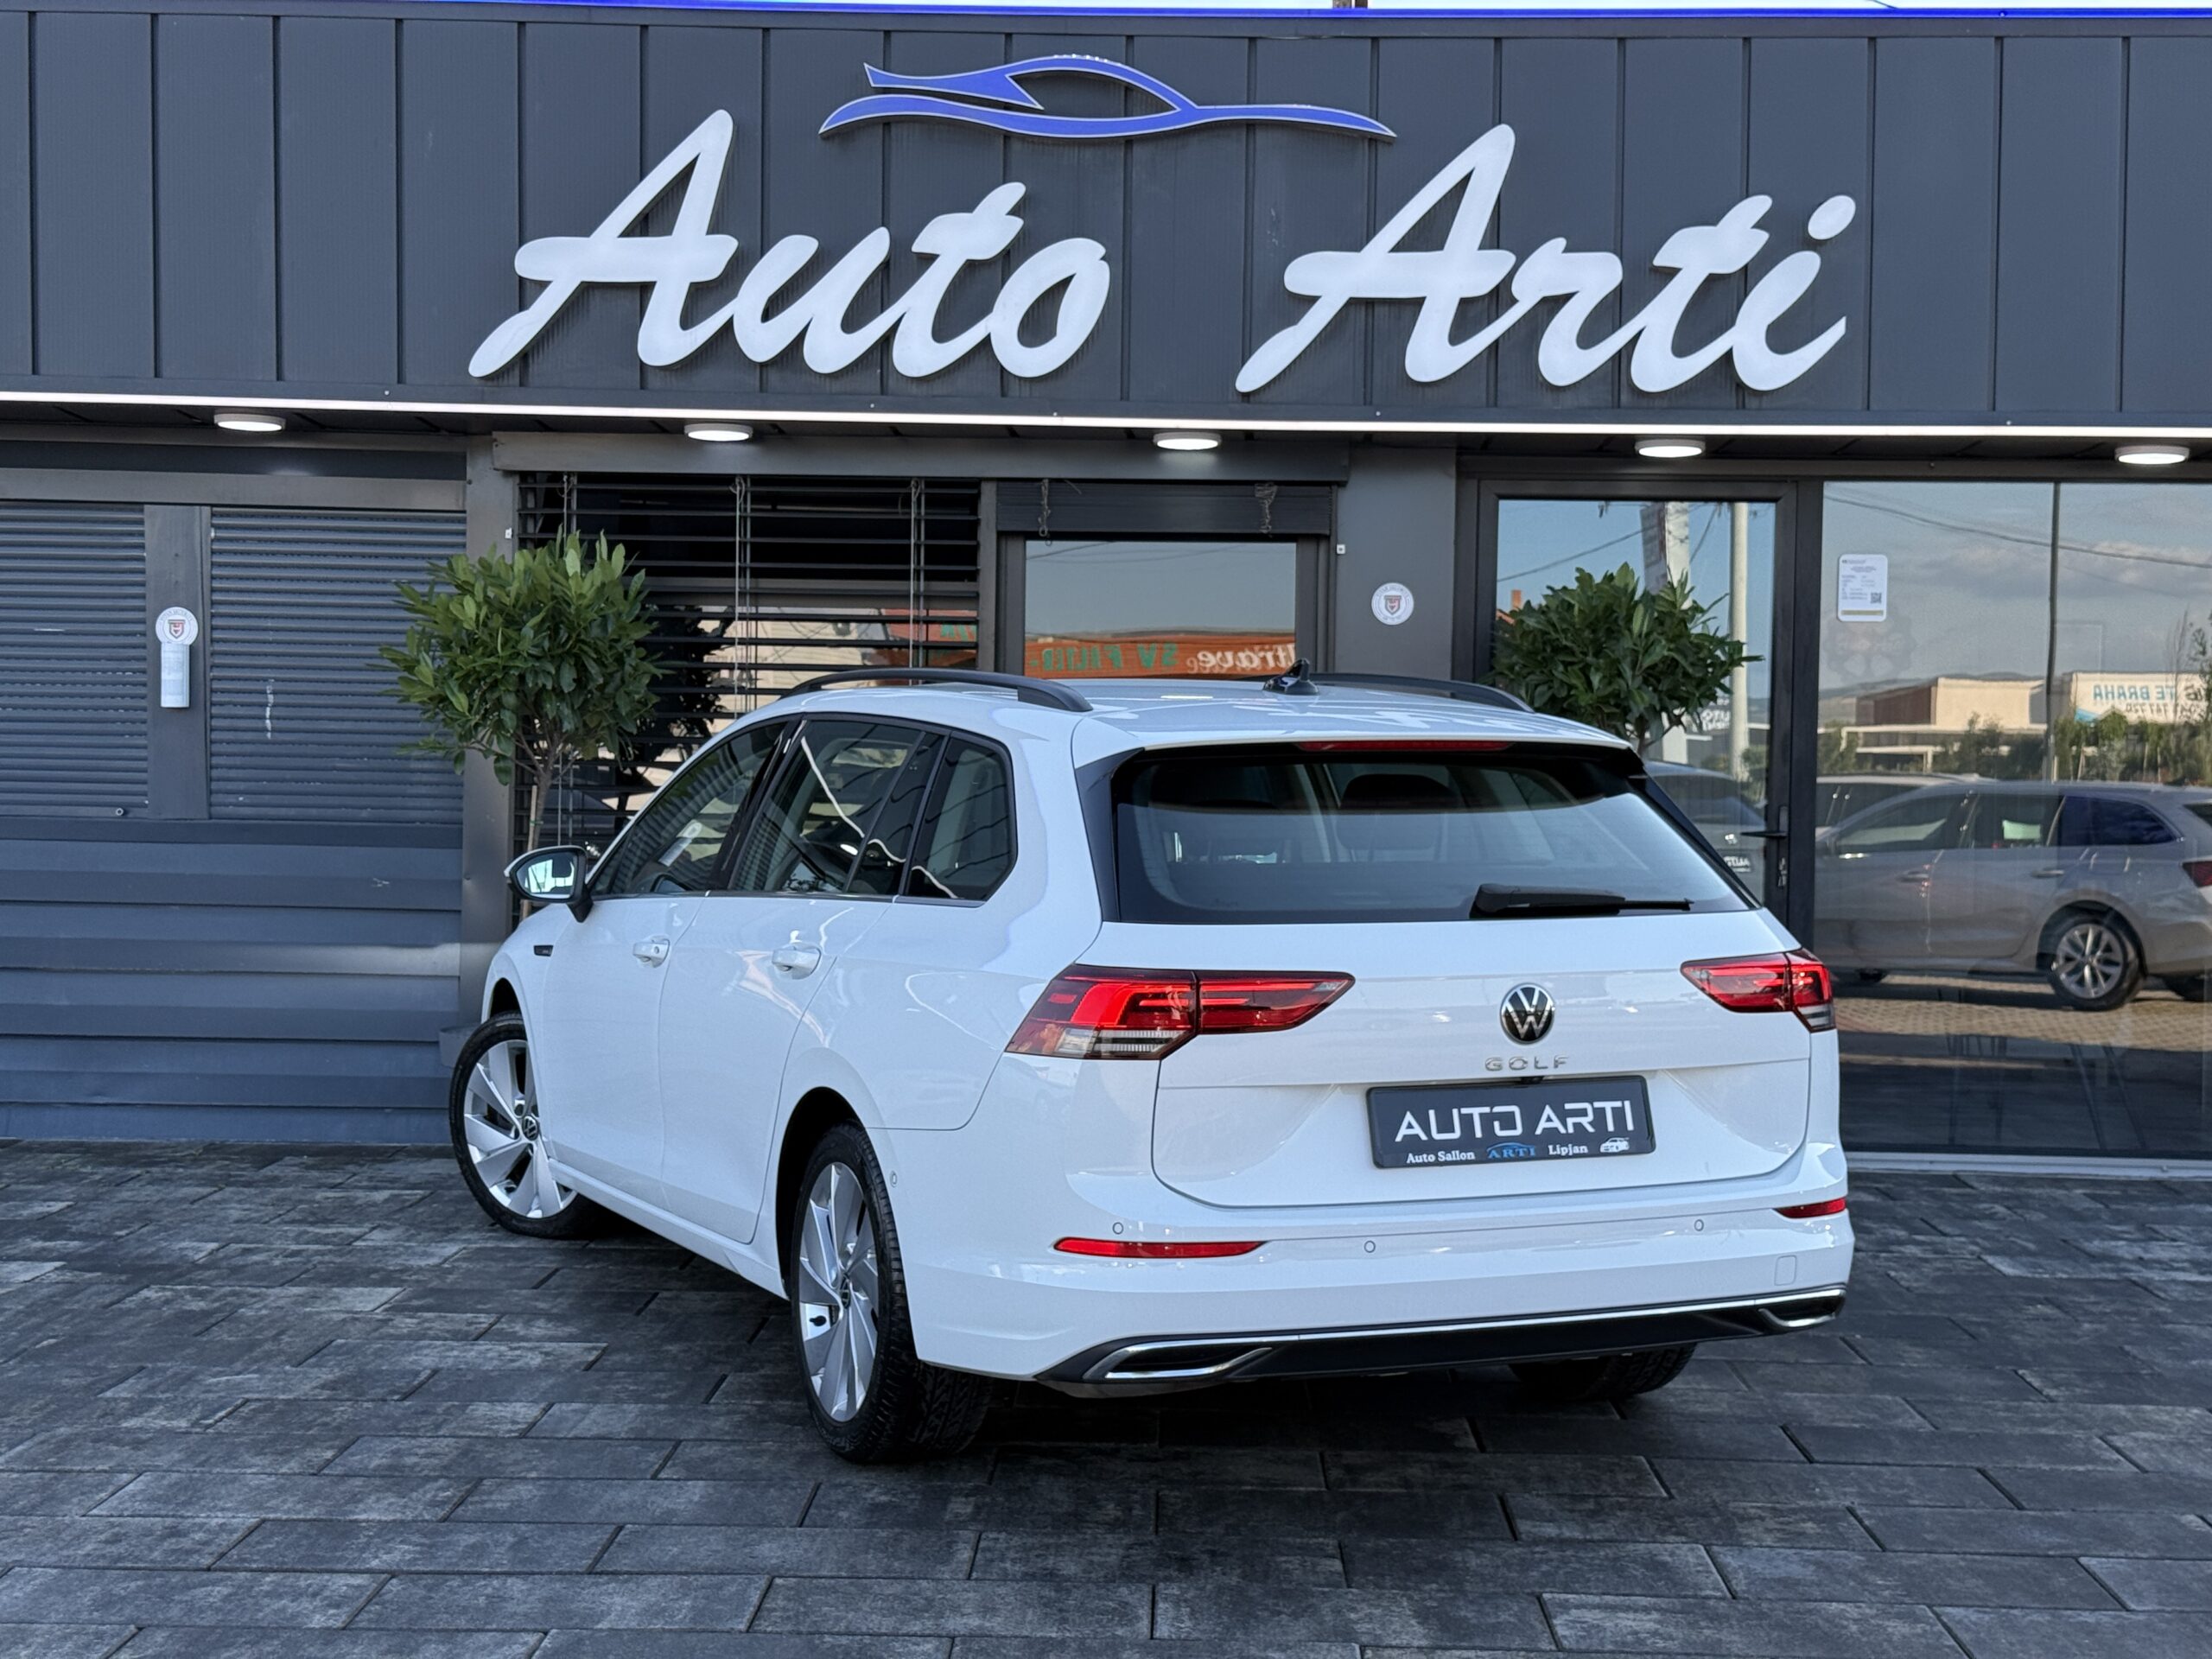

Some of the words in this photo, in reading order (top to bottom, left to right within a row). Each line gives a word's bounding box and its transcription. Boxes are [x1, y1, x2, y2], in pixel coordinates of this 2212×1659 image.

[468, 109, 1110, 378] Auto
[1236, 124, 1856, 393] Arti
[1484, 1055, 1570, 1071] GOLF
[1395, 1105, 1523, 1142] AUTO
[1535, 1100, 1635, 1135] ARTI
[1406, 1153, 1436, 1164] Auto
[1437, 1149, 1476, 1163] Sallon
[1487, 1145, 1536, 1160] ARTI
[1548, 1143, 1589, 1157] Lipjan
